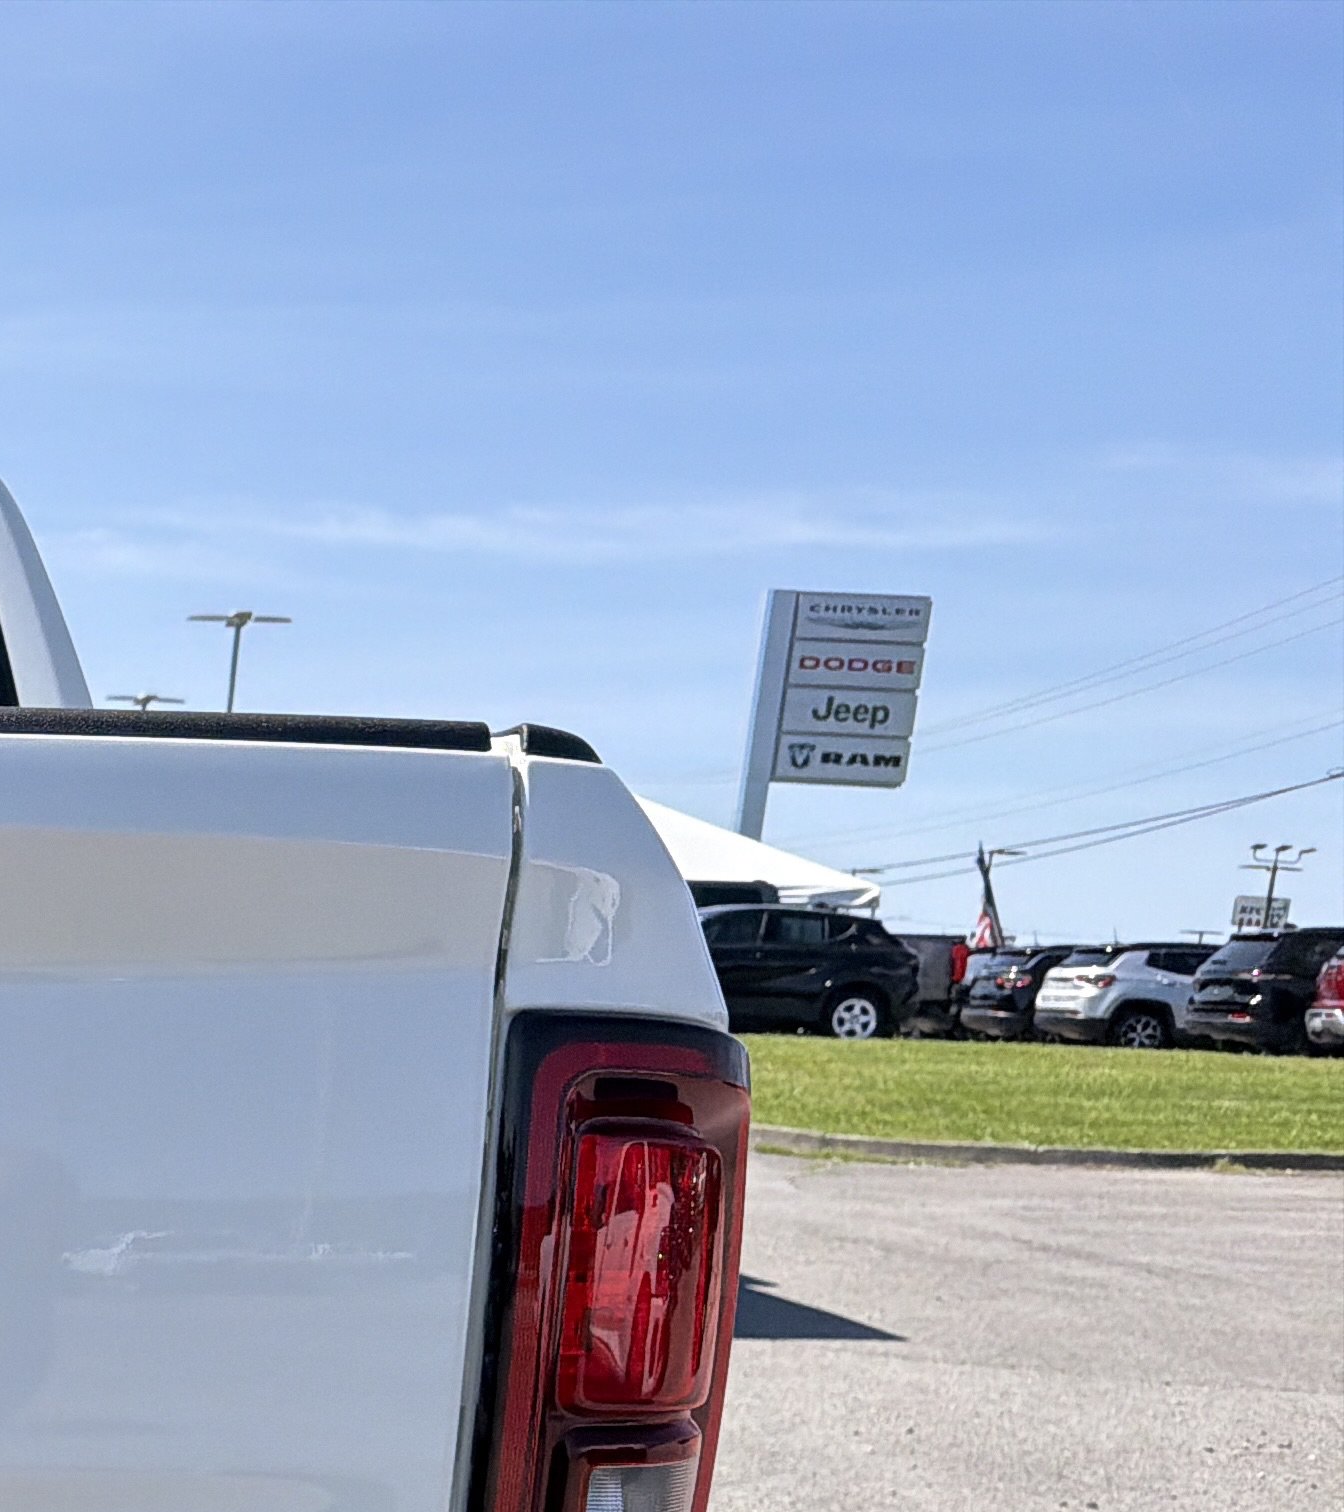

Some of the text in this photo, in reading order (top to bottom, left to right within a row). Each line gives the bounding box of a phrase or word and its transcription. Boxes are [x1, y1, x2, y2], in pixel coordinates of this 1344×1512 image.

[809, 604, 921, 616] CHRYSLER
[799, 656, 916, 674] DODGE
[812, 695, 890, 729] Jeep
[820, 752, 901, 768] RAM
